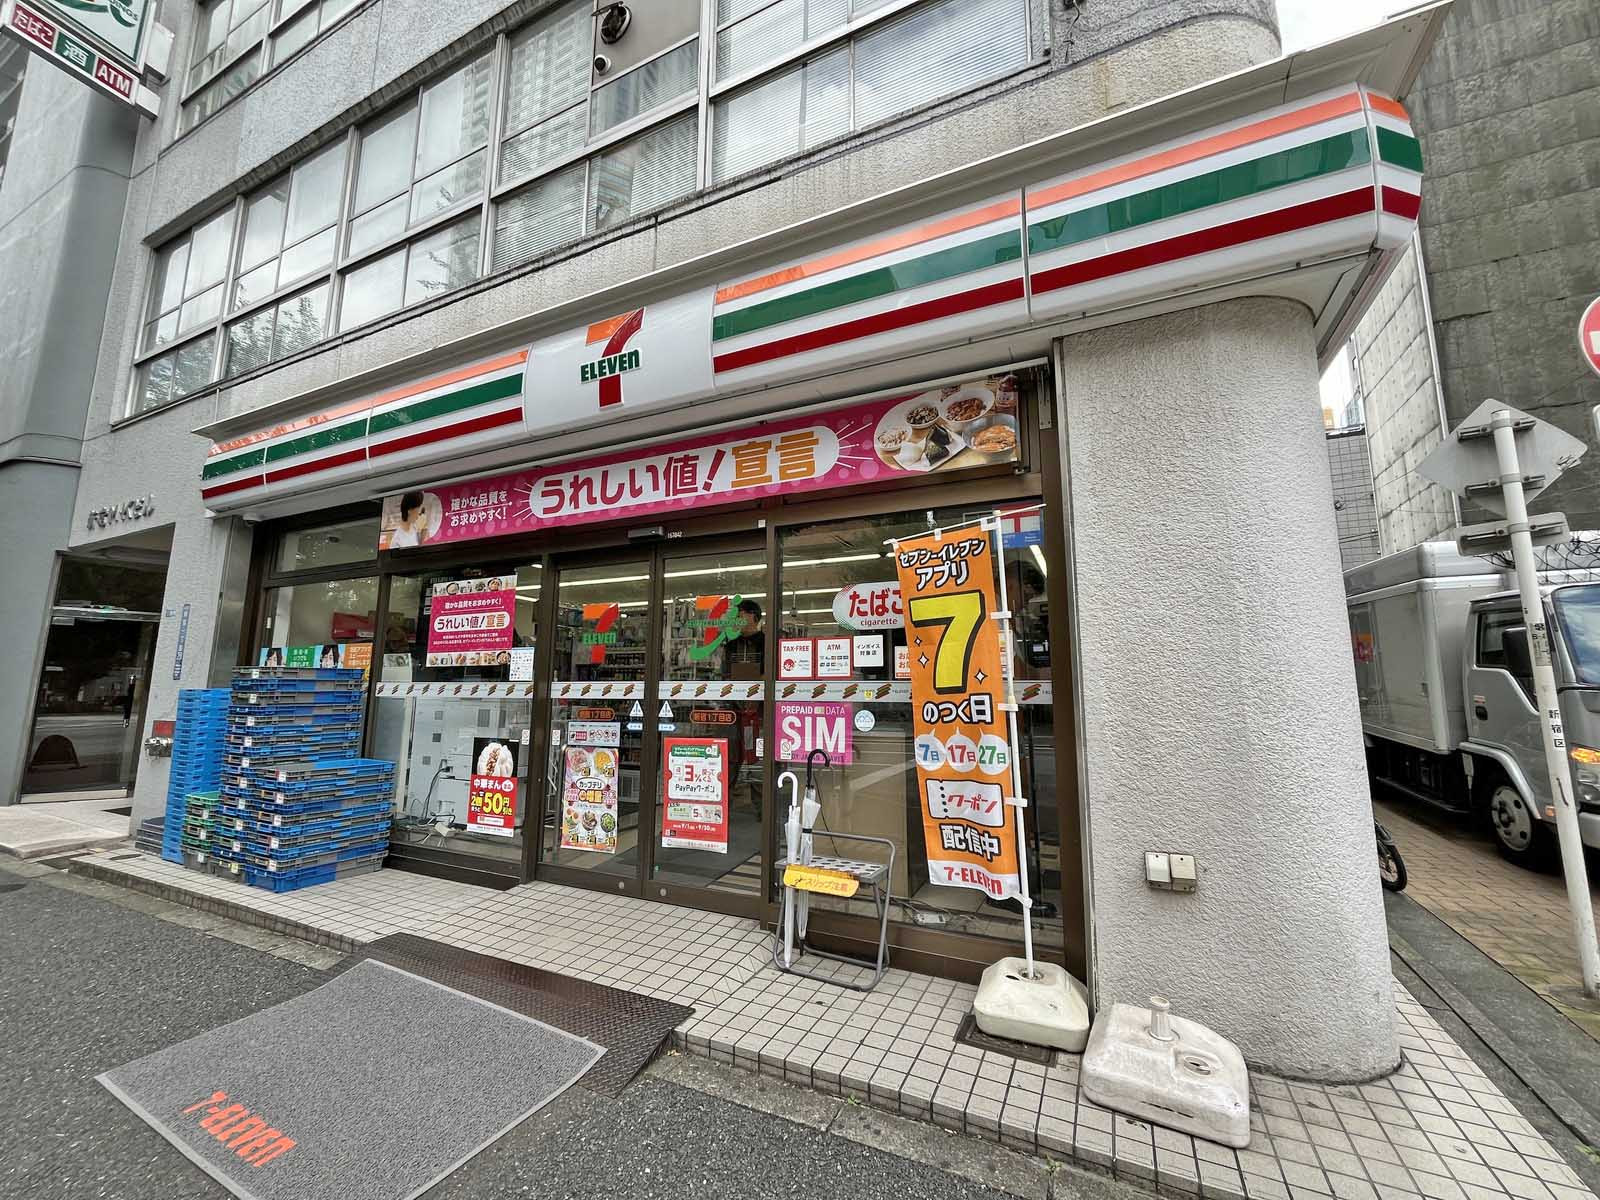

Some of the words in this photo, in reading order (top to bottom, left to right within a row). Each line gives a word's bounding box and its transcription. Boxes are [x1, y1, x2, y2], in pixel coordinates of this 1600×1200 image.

[14, 9, 53, 45] たばこ
[63, 39, 89, 67] 酒
[97, 64, 131, 95] ATM
[585, 307, 645, 408] 7
[540, 431, 820, 515] うれしい値!宣言
[451, 490, 507, 511] 確かな品質を
[450, 506, 507, 527] お求めやすく!
[915, 560, 969, 590] アプリ
[849, 588, 904, 618] たばこ
[437, 613, 506, 630] うれしい値!宣言
[860, 617, 898, 627] cigarette
[908, 589, 986, 695] 7
[781, 705, 813, 714] PREPAID
[825, 706, 845, 715] DATA
[922, 693, 993, 725] のつく日
[782, 715, 846, 754] SIM
[1548, 709, 1566, 748] 新宿区
[919, 743, 940, 762] 7日
[948, 744, 977, 764] 17日
[978, 745, 1007, 765] 27日
[482, 791, 503, 815] 50
[947, 794, 998, 814] クーポン
[939, 824, 1001, 862] 配信中
